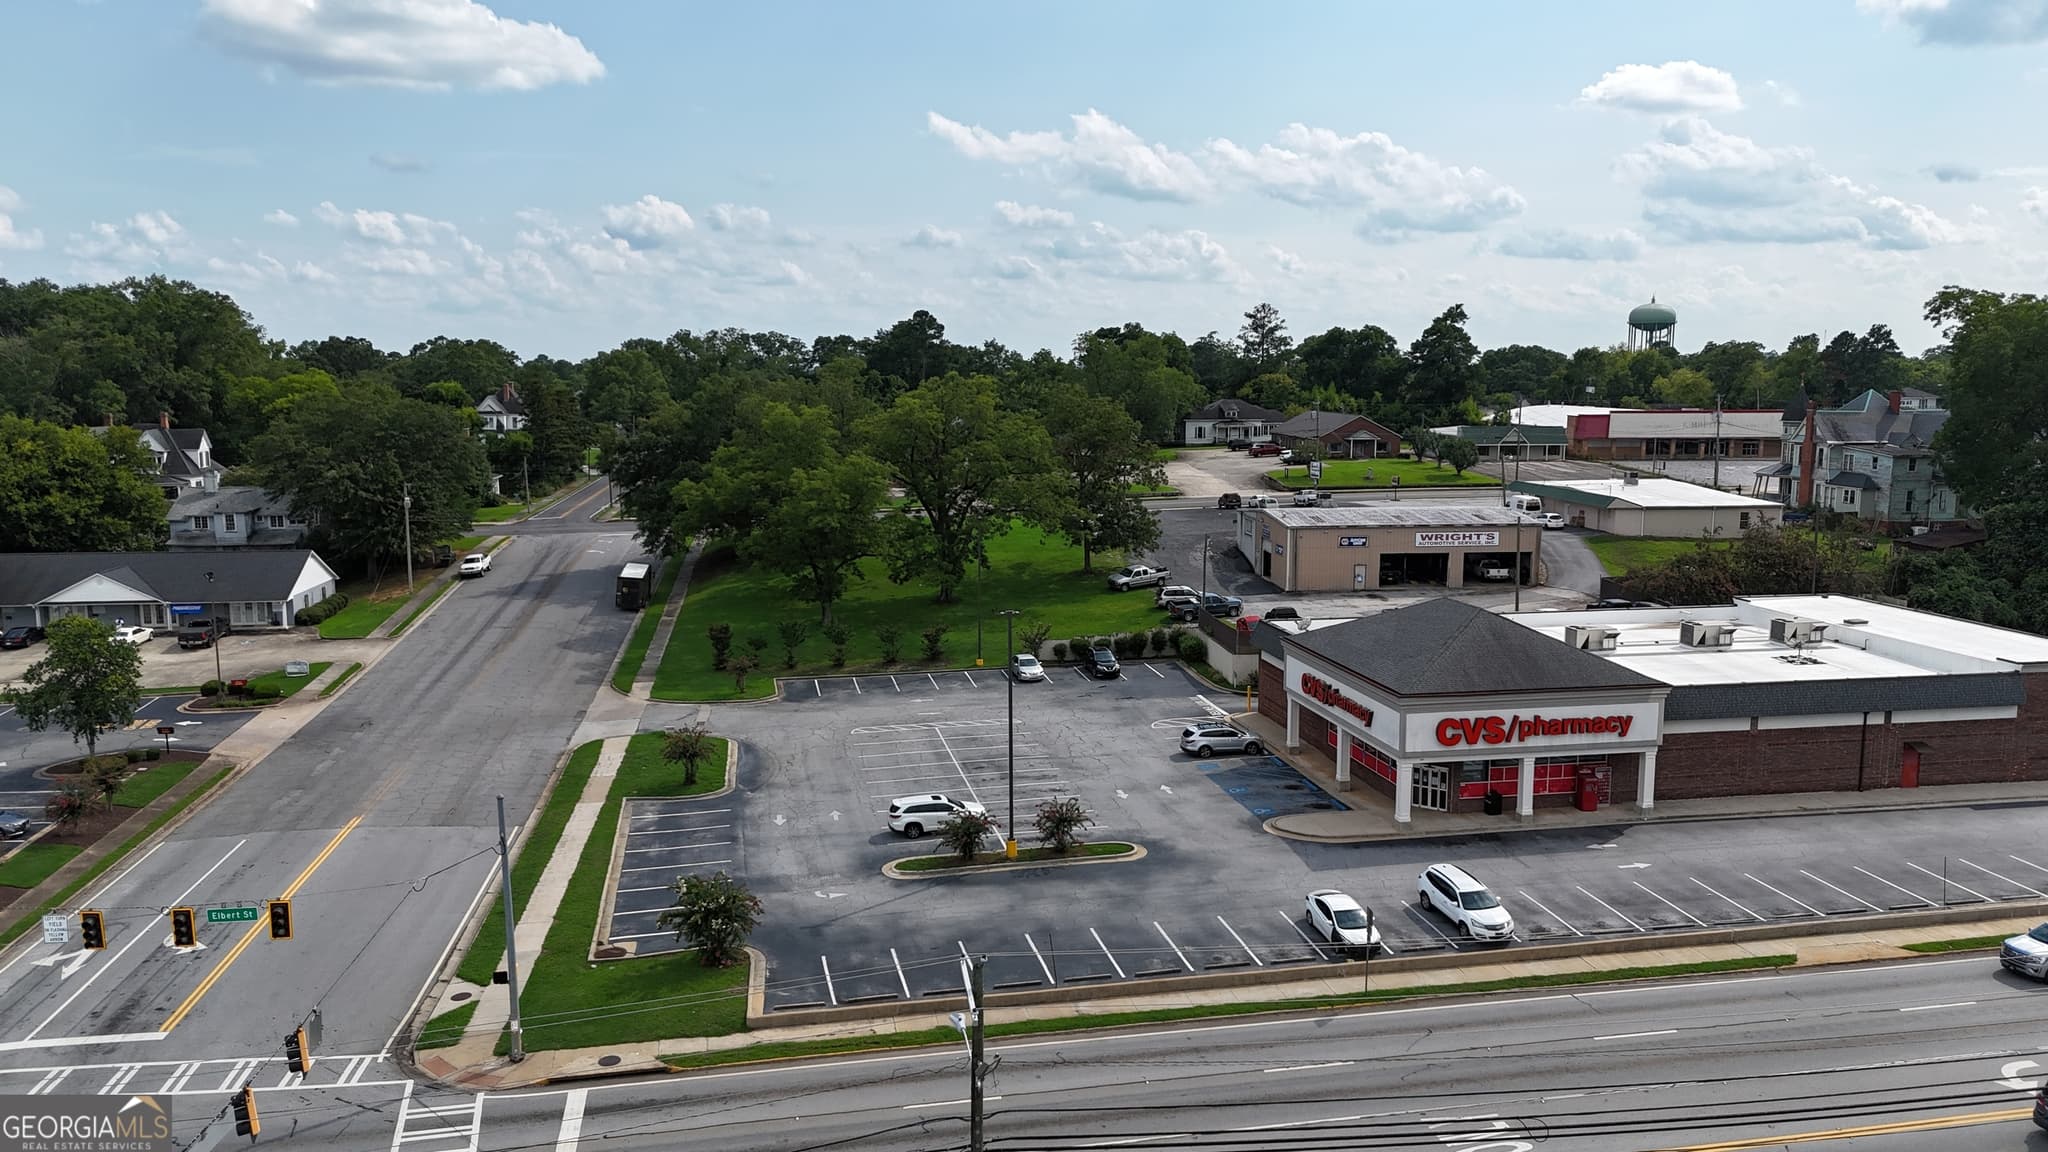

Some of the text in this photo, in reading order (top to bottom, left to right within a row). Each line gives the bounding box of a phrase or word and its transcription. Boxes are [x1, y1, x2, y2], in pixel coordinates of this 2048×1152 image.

[1420, 533, 1495, 541] WRIGHT'S
[1436, 715, 1634, 746] CVS/pharmacy
[212, 911, 240, 920] Elbert
